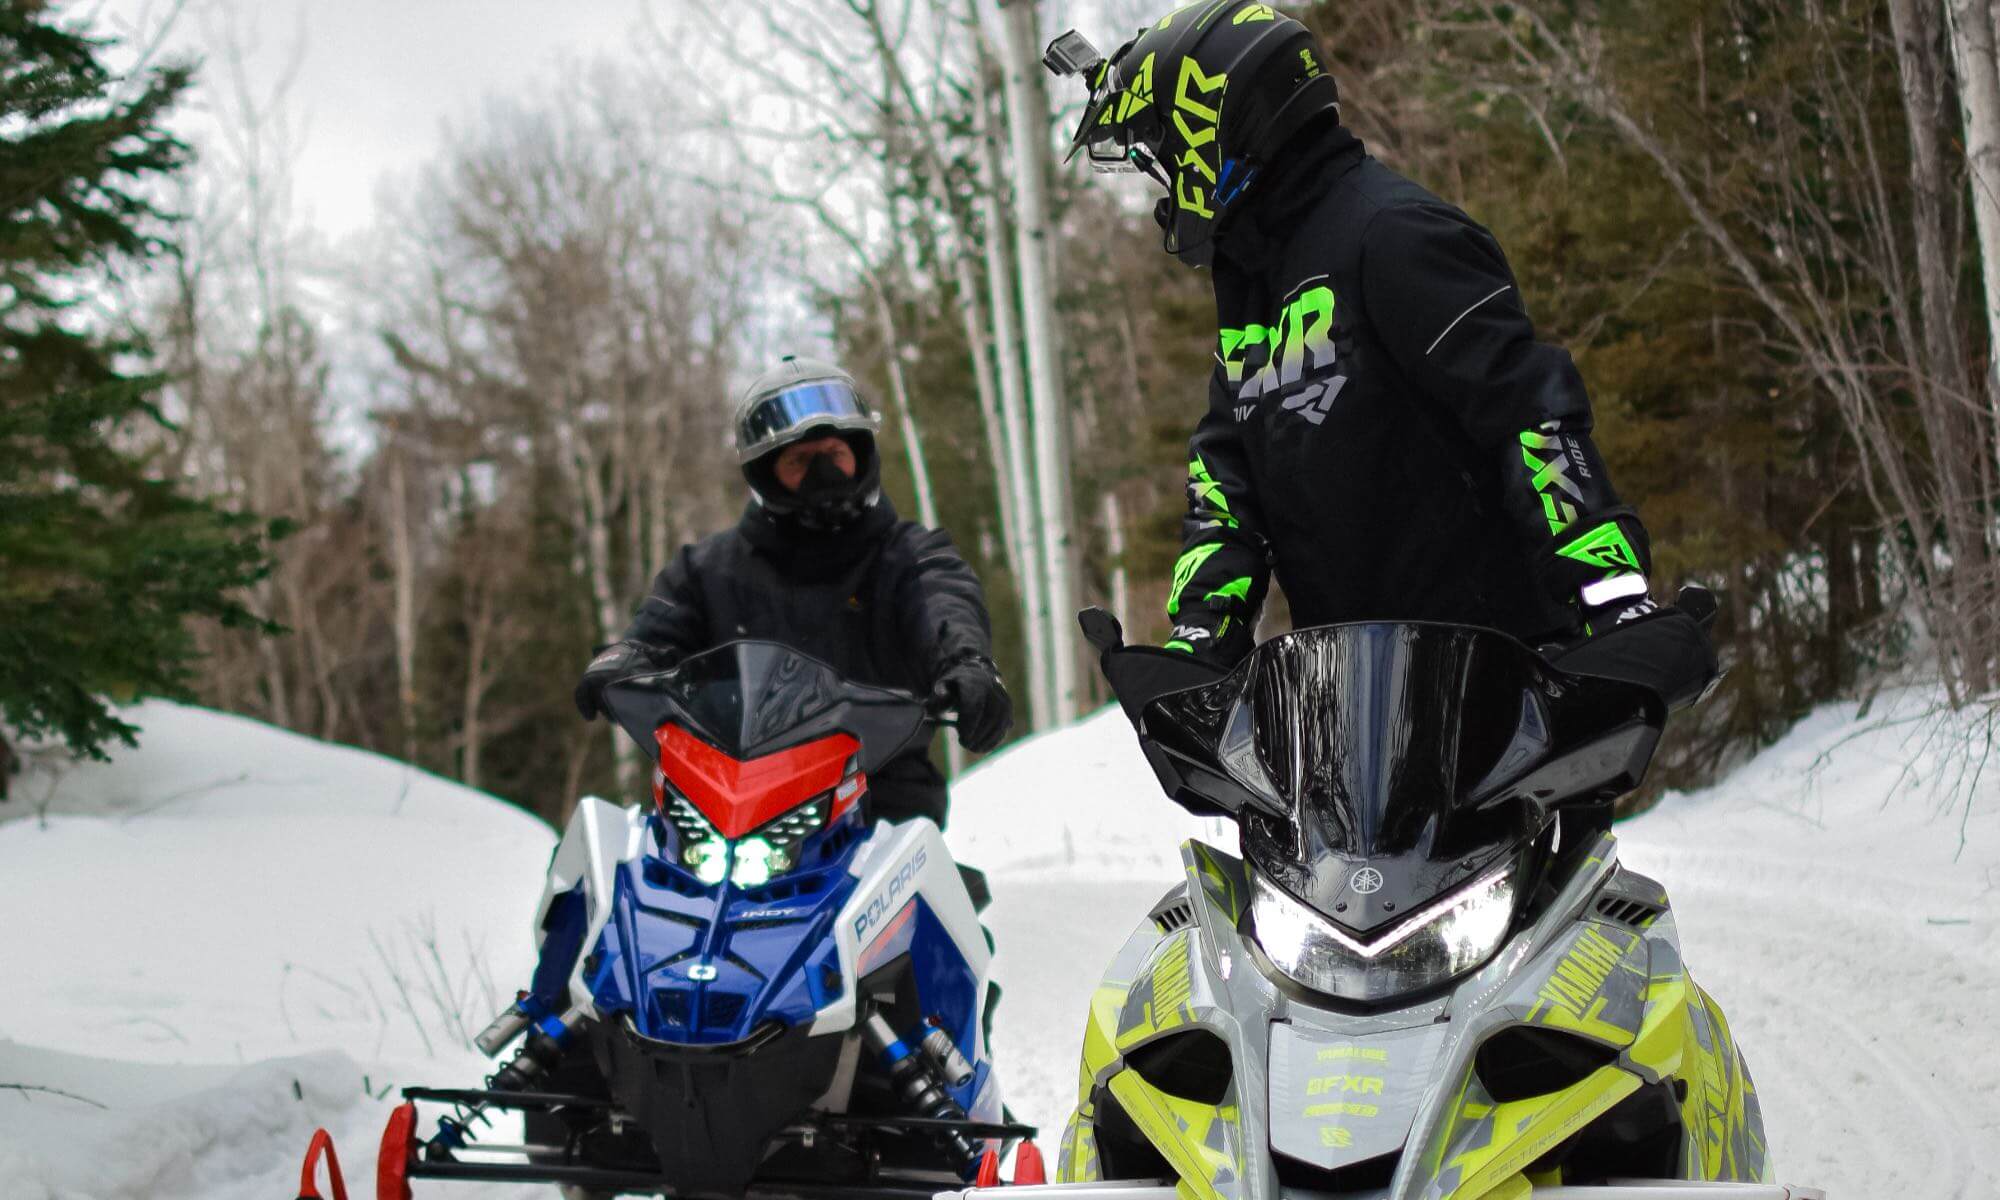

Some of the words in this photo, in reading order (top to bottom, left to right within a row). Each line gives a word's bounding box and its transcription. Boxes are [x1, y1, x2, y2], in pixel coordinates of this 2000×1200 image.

[1173, 55, 1227, 219] FXR
[1566, 436, 1592, 478] RIDE
[742, 908, 796, 919] INDY
[854, 845, 928, 943] POLARIS
[1539, 927, 1624, 1015] YAMAHA
